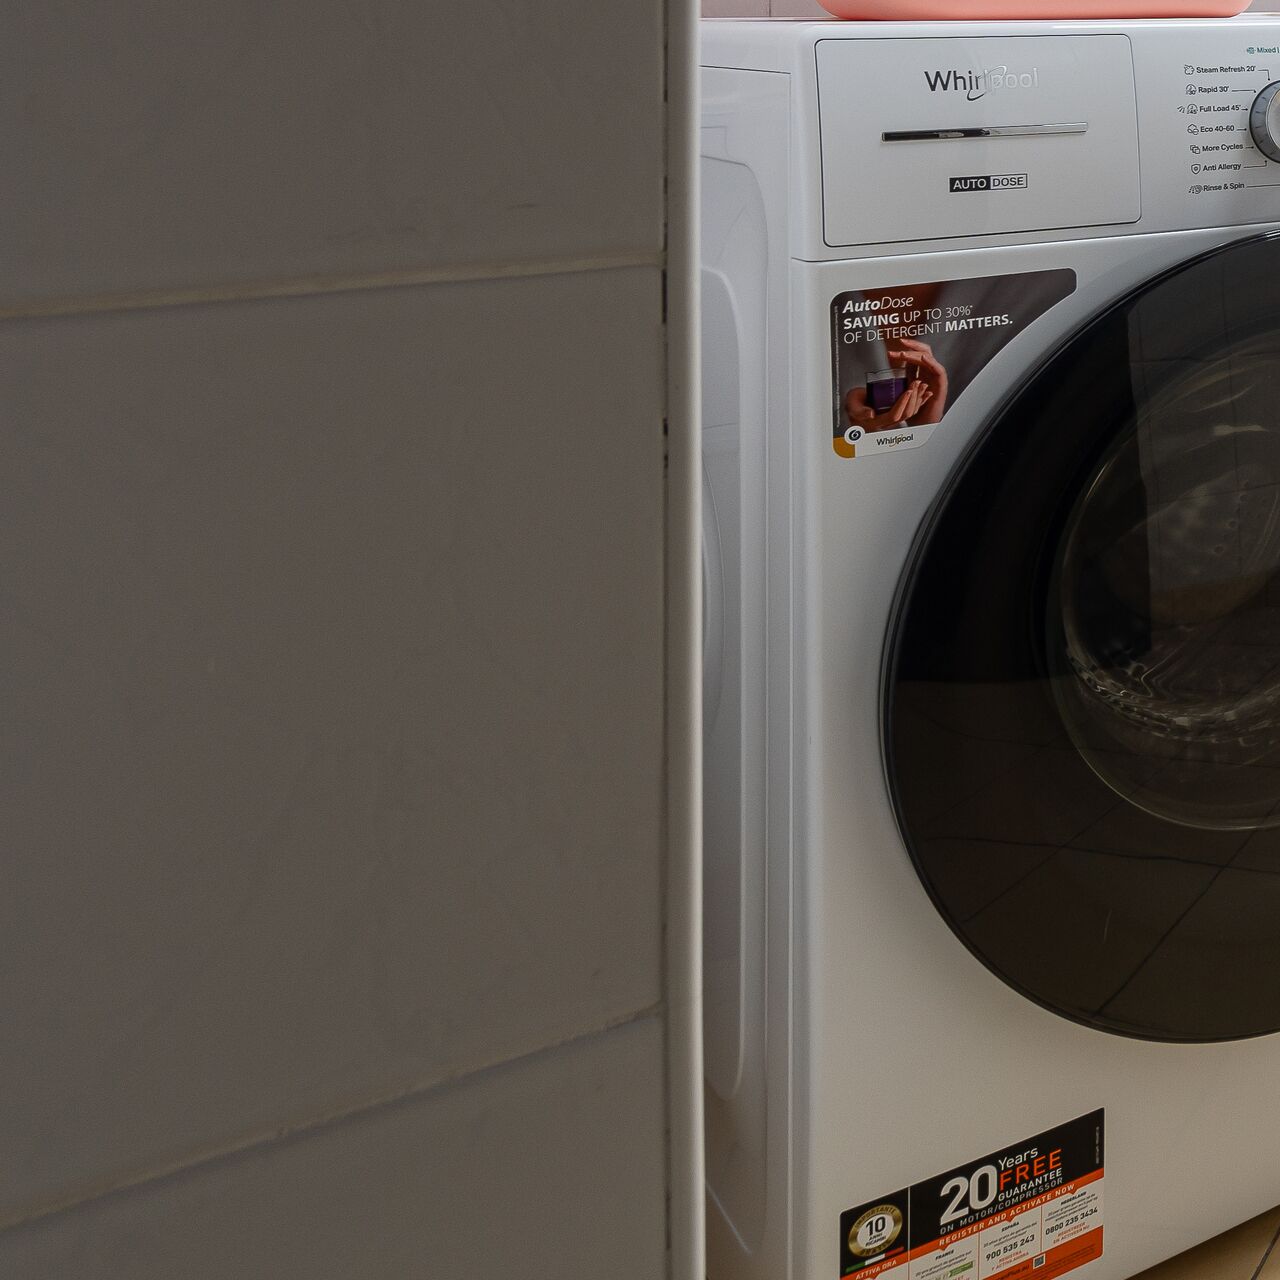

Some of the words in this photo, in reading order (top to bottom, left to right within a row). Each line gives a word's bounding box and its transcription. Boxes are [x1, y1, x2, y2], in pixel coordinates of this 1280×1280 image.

[924, 65, 1040, 101] Whirlpool
[1218, 163, 1241, 171] Allergy
[953, 179, 986, 190] AUTO
[993, 177, 1024, 186] DOSE
[1229, 183, 1244, 191] Spin
[843, 296, 913, 314] AutoDose
[844, 313, 899, 329] SAVING
[903, 310, 921, 323] UP
[924, 308, 941, 320] TO
[844, 332, 862, 344] OF
[867, 322, 942, 341] DETERGENT
[945, 314, 1013, 332] MATTERS.
[876, 434, 913, 447] Whirlpool
[999, 1148, 1038, 1170] Years
[1000, 1149, 1062, 1190] FREE
[940, 1165, 998, 1225] 20
[998, 1168, 1062, 1202] GUARANTEE
[939, 1221, 985, 1246] REGISTER
[988, 1212, 1007, 1227] AND
[1010, 1198, 1052, 1217] ACTIVATE
[1055, 1183, 1075, 1199] NOW
[940, 1224, 954, 1235] ON
[960, 1177, 1063, 1227] MOTOR/COMPRESSOR
[866, 1216, 886, 1236] 10
[1045, 1222, 1063, 1235] 0800
[1065, 1216, 1079, 1226] 235
[1081, 1207, 1097, 1219] 3434
[986, 1249, 1000, 1261] 900
[1003, 1242, 1018, 1253] 535
[1020, 1234, 1035, 1246] 243
[856, 1264, 880, 1280] ATTIVA
[882, 1260, 897, 1269] ORA
